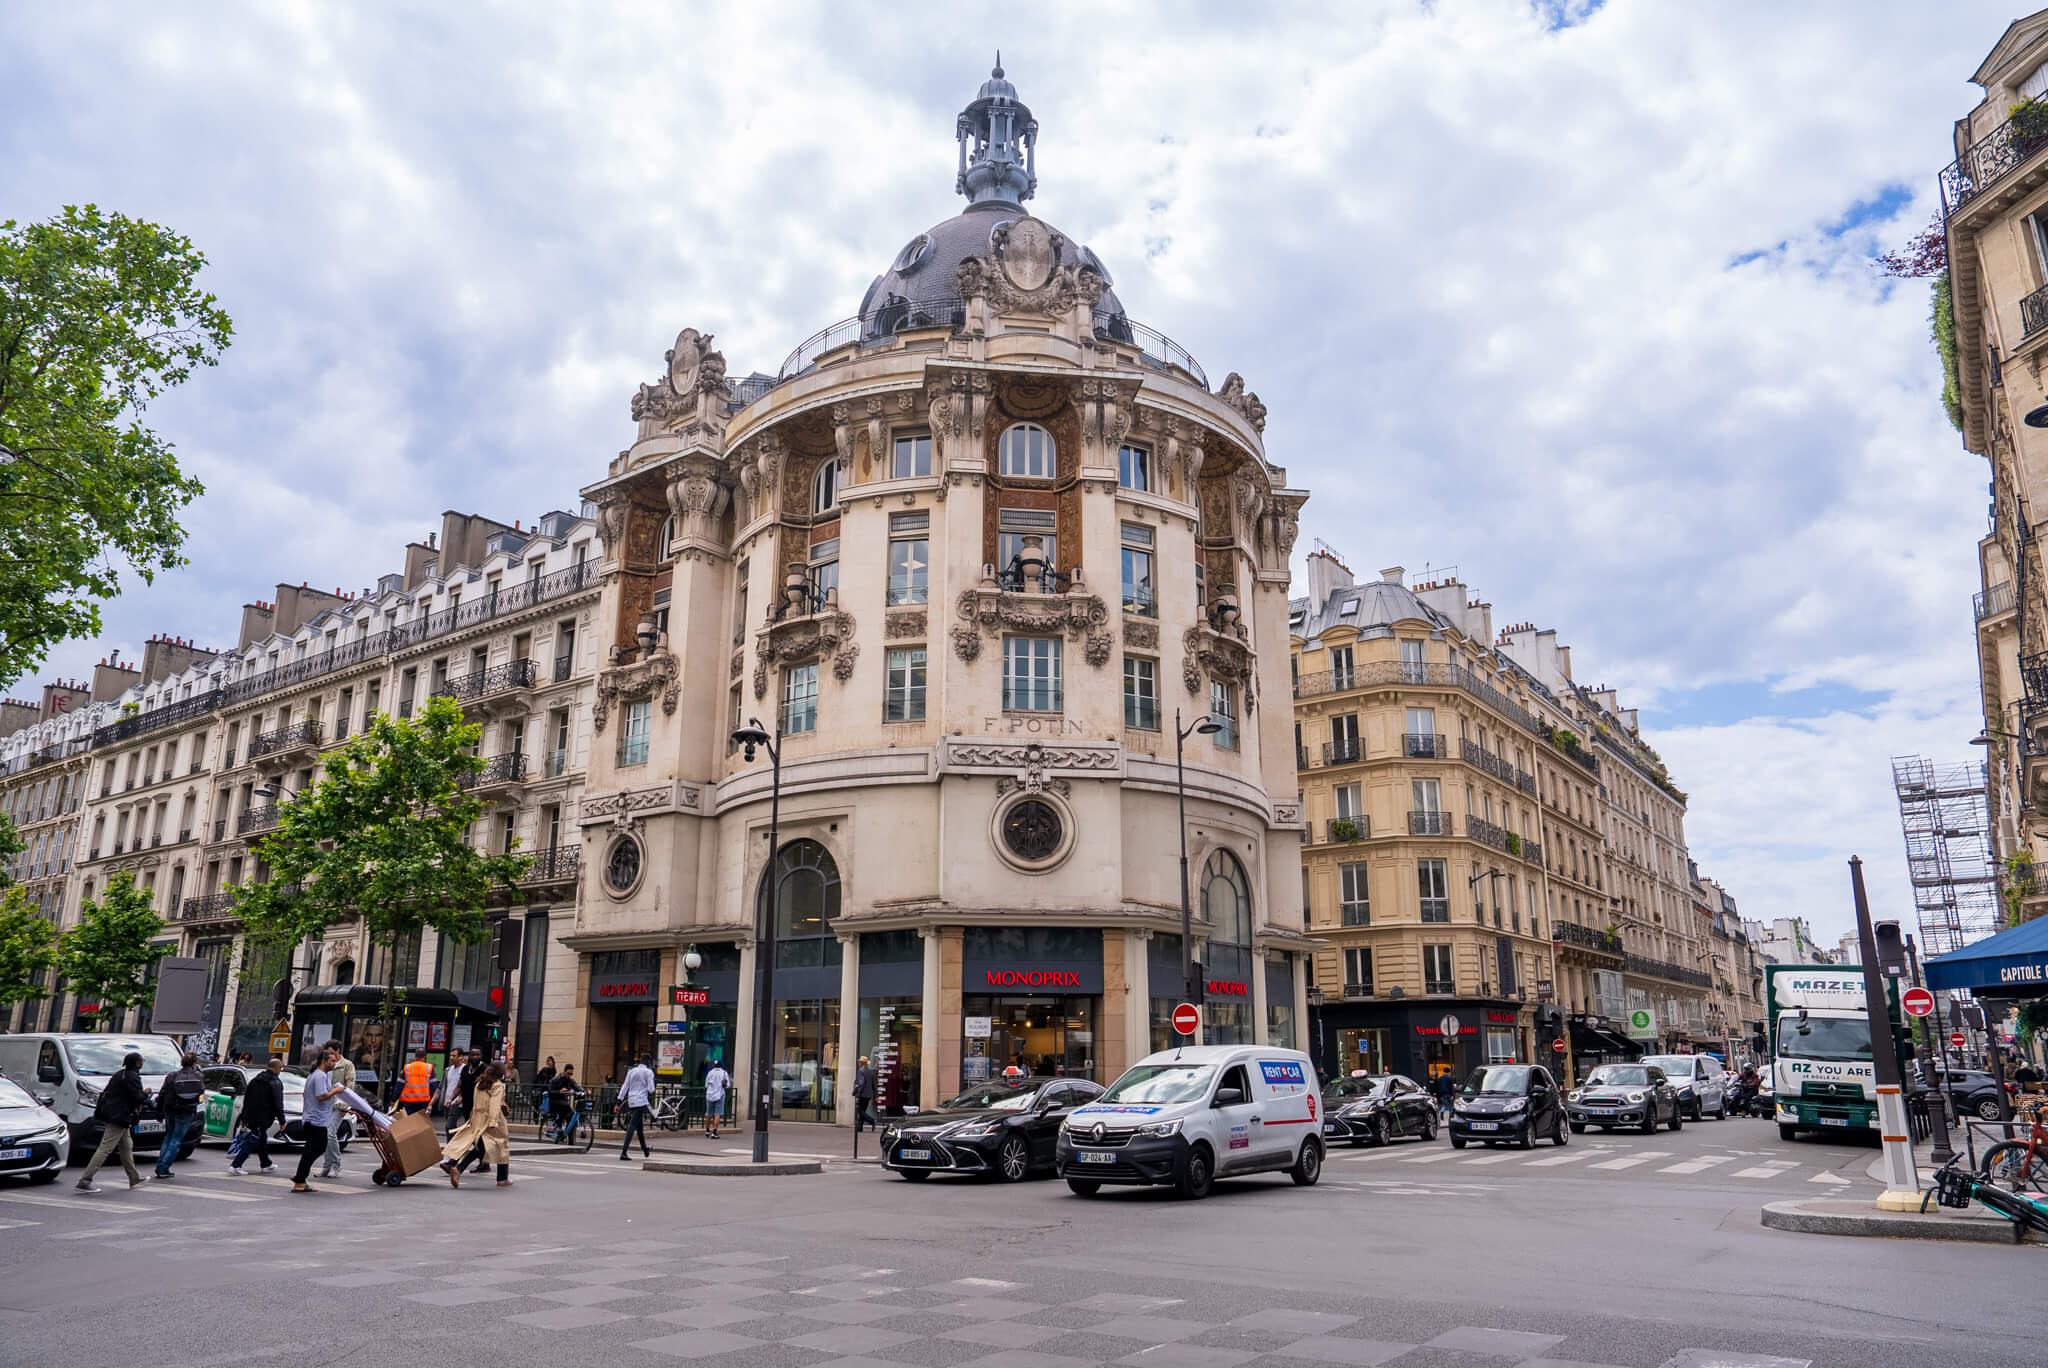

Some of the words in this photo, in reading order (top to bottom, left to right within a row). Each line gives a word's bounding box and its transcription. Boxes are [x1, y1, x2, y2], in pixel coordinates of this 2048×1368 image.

[1009, 718, 1083, 734] POTIN
[986, 969, 1080, 987] MONOPRIX
[2000, 964, 2042, 982] CAPITOLE
[599, 982, 649, 997] MONOPRIX
[1208, 980, 1248, 996] MONOPRIX
[1264, 1066, 1282, 1079] RENT
[1288, 1066, 1302, 1079] CAR
[1792, 1063, 1812, 1073] AZ
[1816, 1065, 1842, 1075] YOU
[1846, 1067, 1872, 1077] ARE
